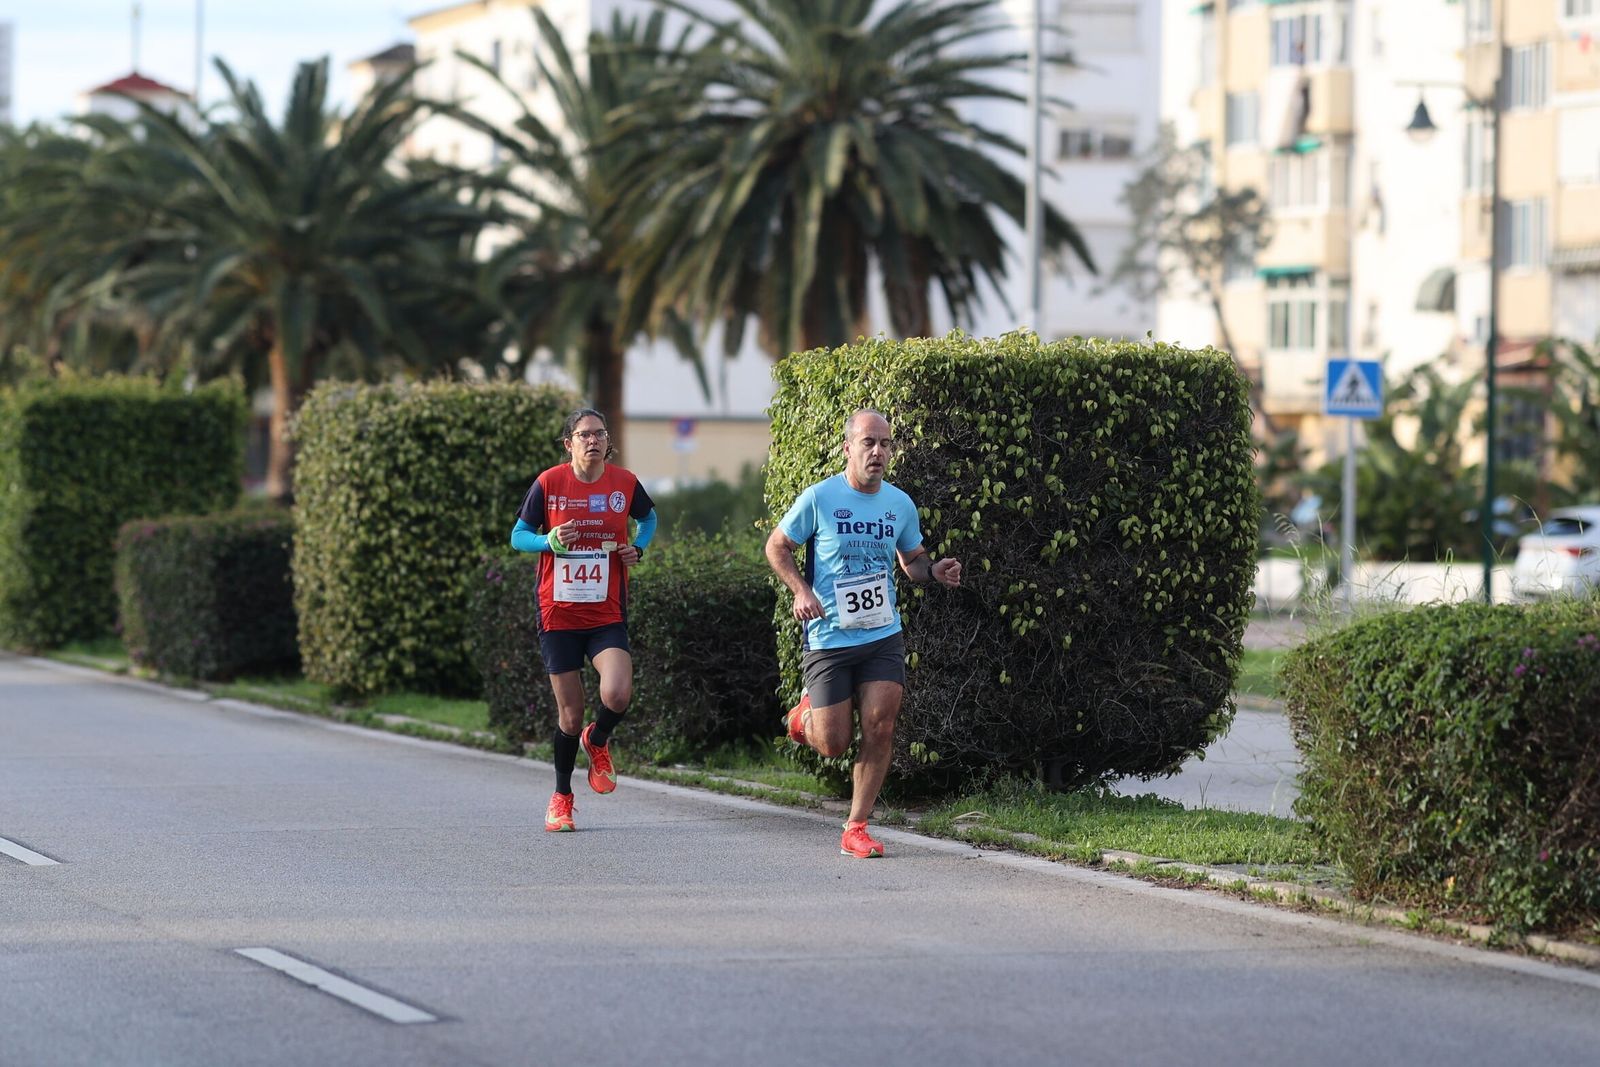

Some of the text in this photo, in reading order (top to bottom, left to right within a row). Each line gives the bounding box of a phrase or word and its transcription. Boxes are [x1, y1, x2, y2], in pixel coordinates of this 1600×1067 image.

[837, 518, 894, 540] nerja
[847, 540, 888, 549] ATLETISMO
[562, 564, 602, 583] 144
[845, 586, 884, 613] 385
